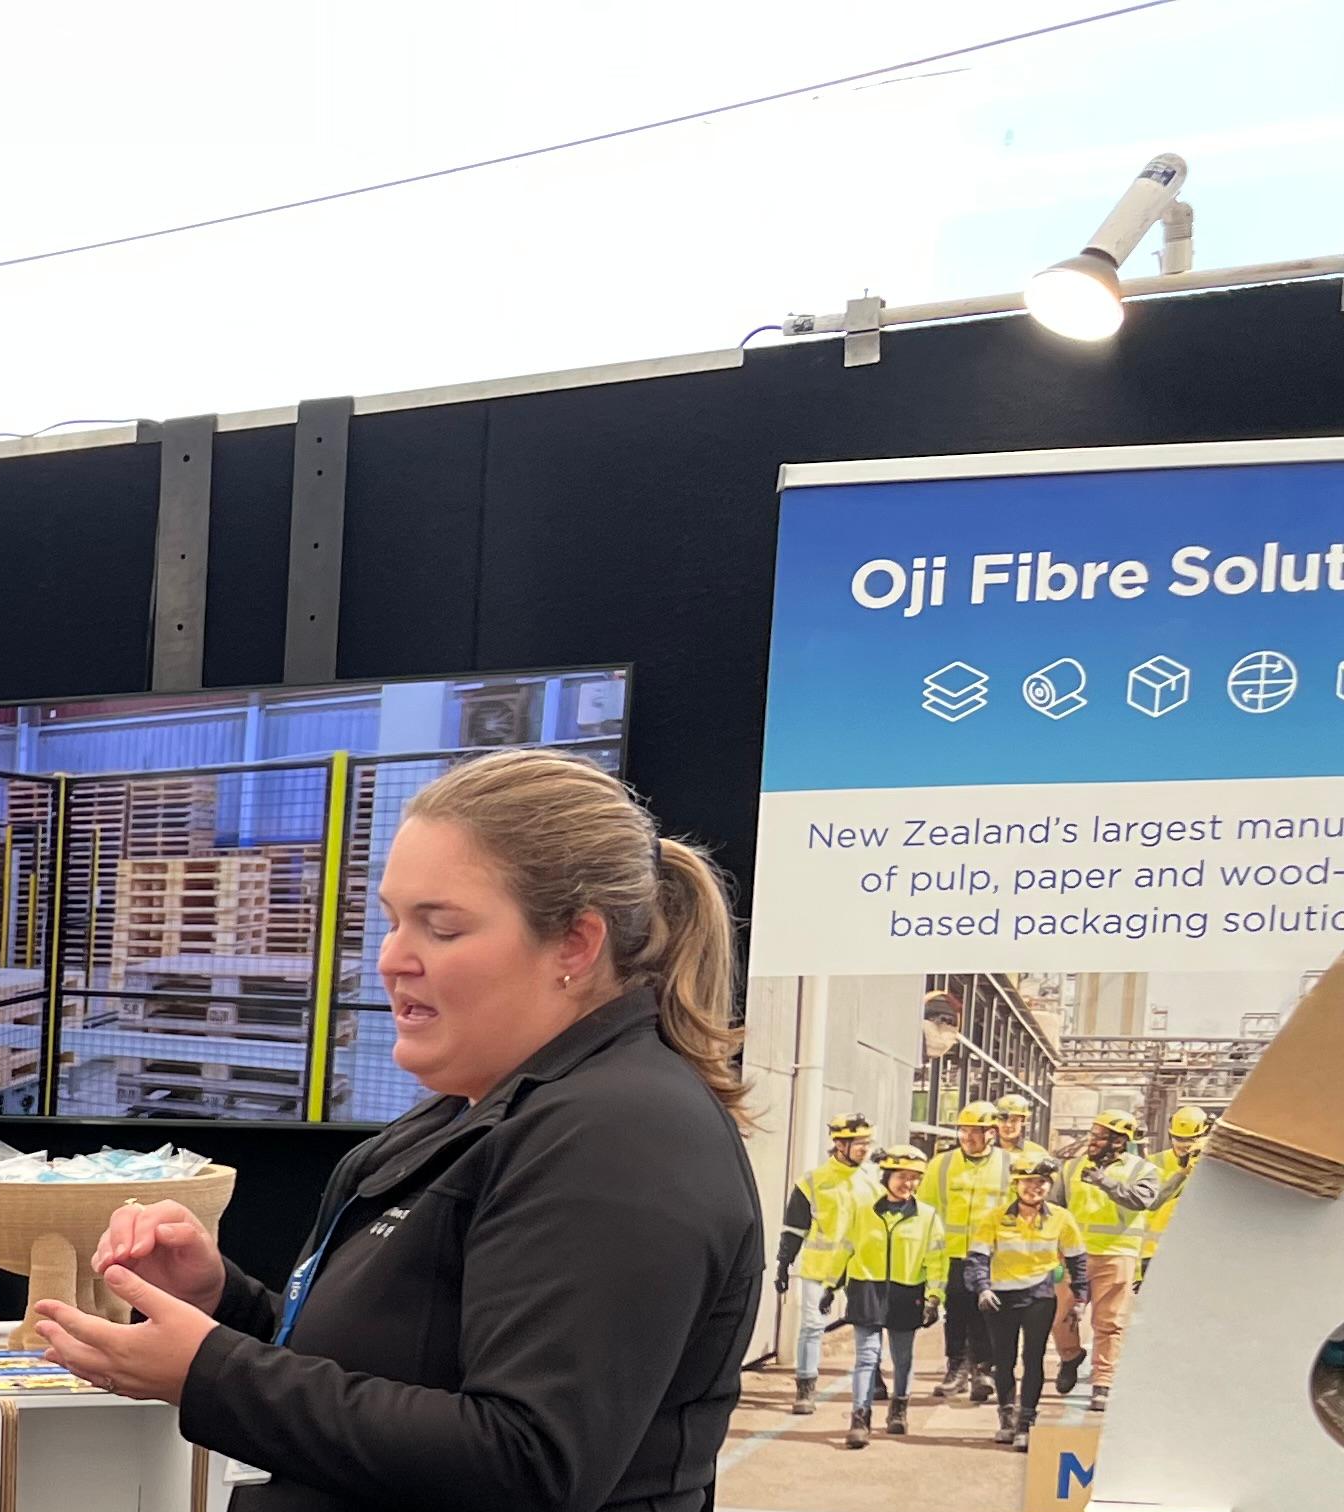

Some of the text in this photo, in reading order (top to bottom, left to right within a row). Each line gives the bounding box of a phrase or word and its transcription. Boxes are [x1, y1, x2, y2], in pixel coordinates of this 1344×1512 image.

[851, 541, 1344, 618] Oji Fibre Solut
[808, 814, 1344, 850] New Zealand's largest manu
[860, 857, 1344, 898] of pulp, paper and wood-
[891, 904, 1344, 941] based packaging solutio
